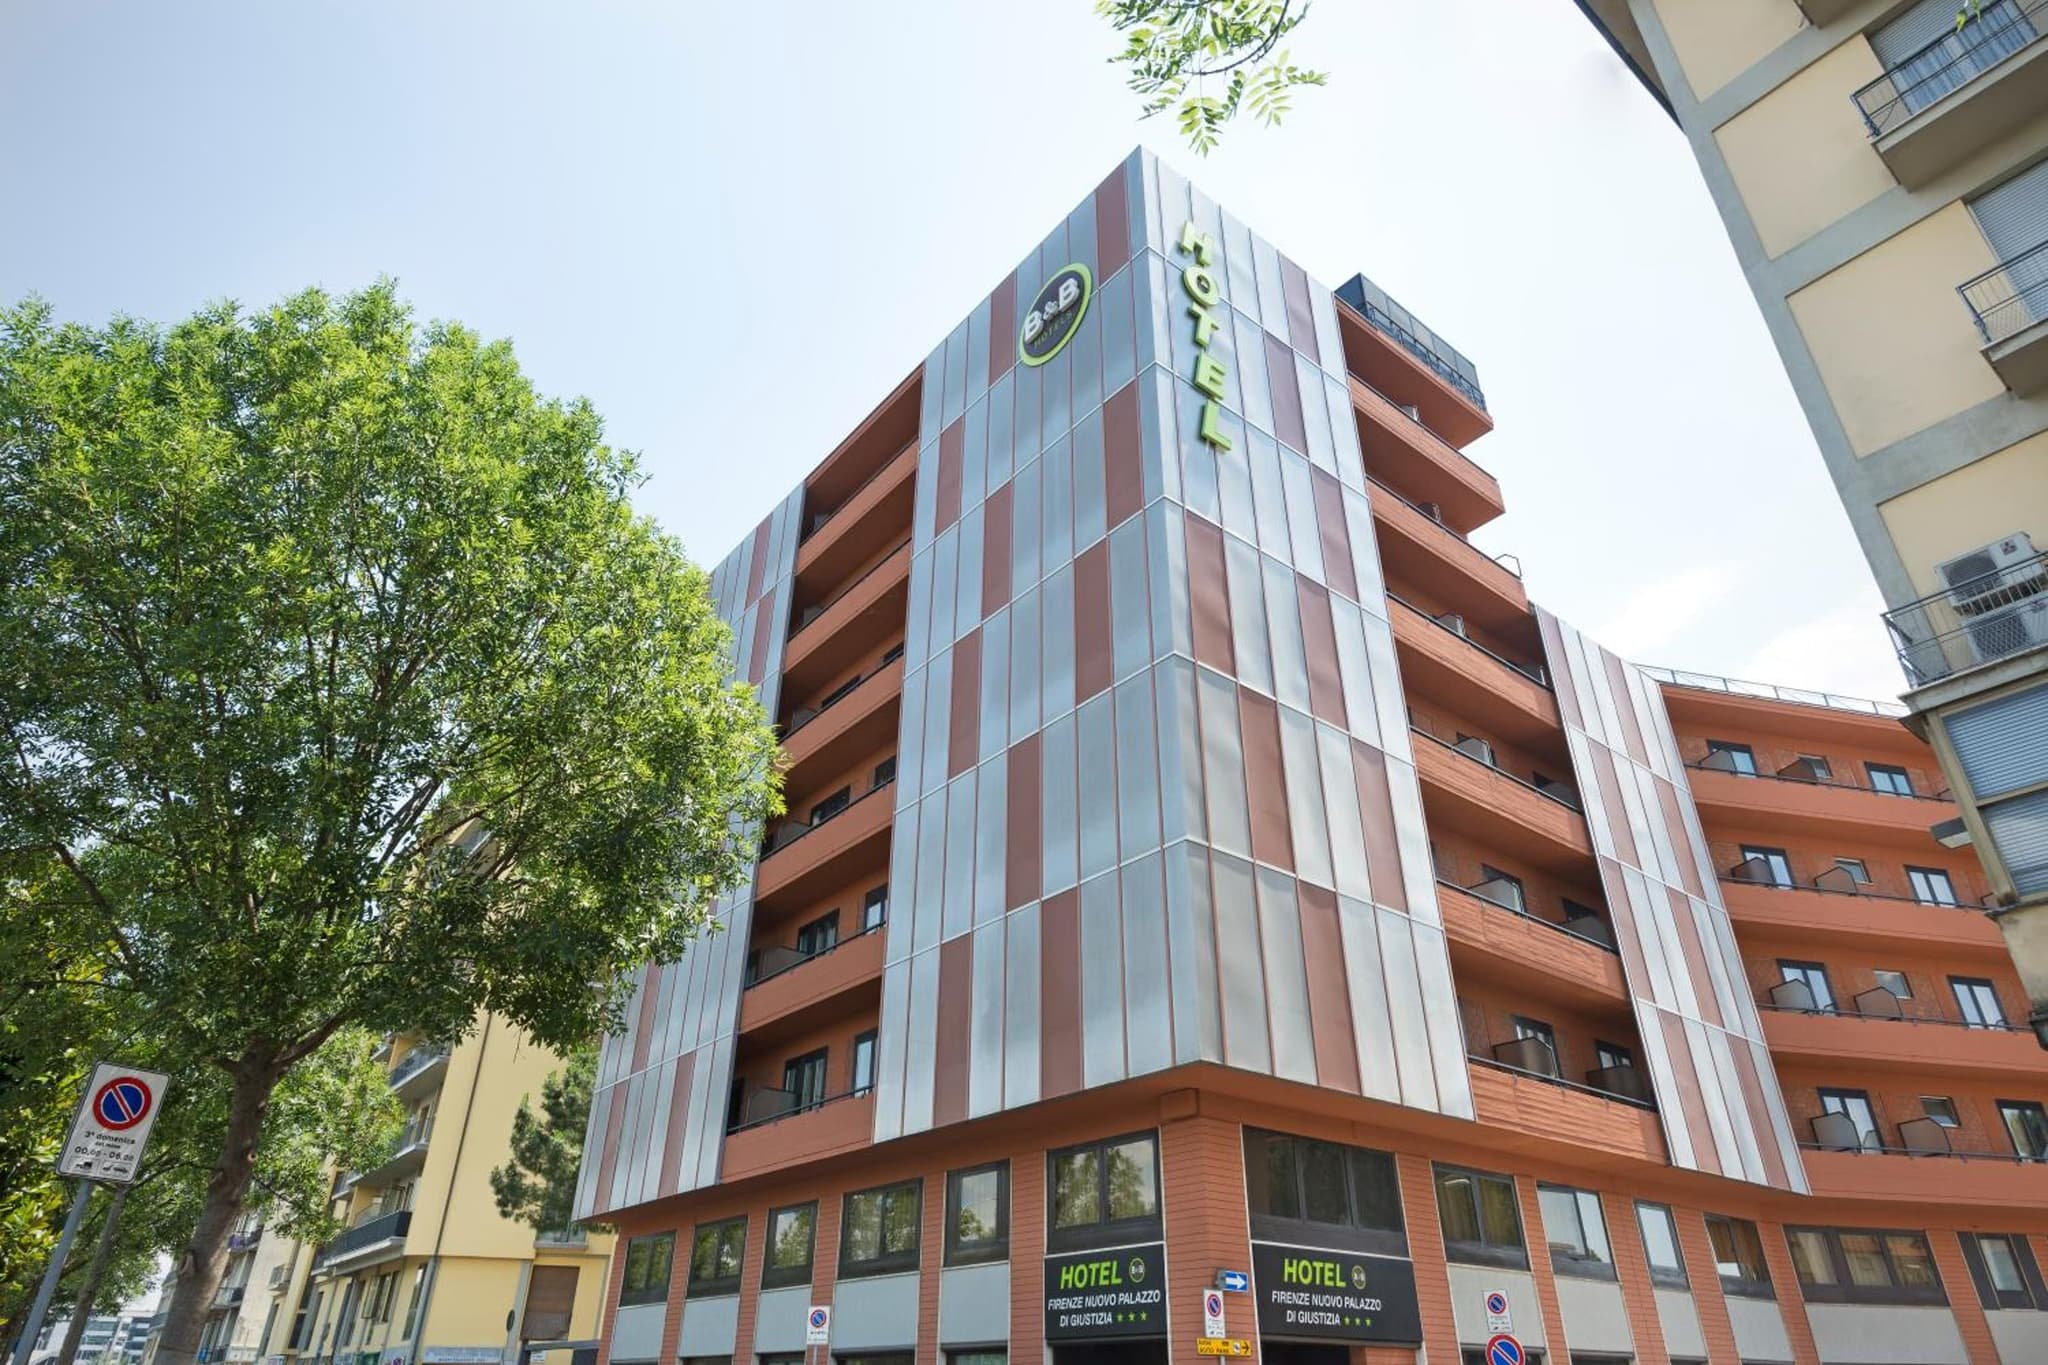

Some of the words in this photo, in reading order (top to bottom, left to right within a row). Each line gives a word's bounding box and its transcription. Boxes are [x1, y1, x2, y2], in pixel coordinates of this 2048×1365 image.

[1024, 278, 1080, 344] B&B
[1178, 220, 1232, 452] HOTEL
[1060, 1261, 1122, 1290] HOTEL
[1283, 1258, 1347, 1288] HOTEL
[1048, 1297, 1083, 1311] FIRENZE
[1085, 1294, 1117, 1308] NUOVO
[1118, 1290, 1161, 1305] PALAZZO
[1272, 1290, 1310, 1305] FIRENZE
[1312, 1294, 1343, 1308] NUOVO
[1344, 1297, 1382, 1312] PALAZZO
[1060, 1315, 1069, 1327] DI
[1070, 1312, 1113, 1327] GIUSTIZIA
[1286, 1310, 1297, 1323] DI
[1297, 1311, 1341, 1326] GIUSTIZIA
